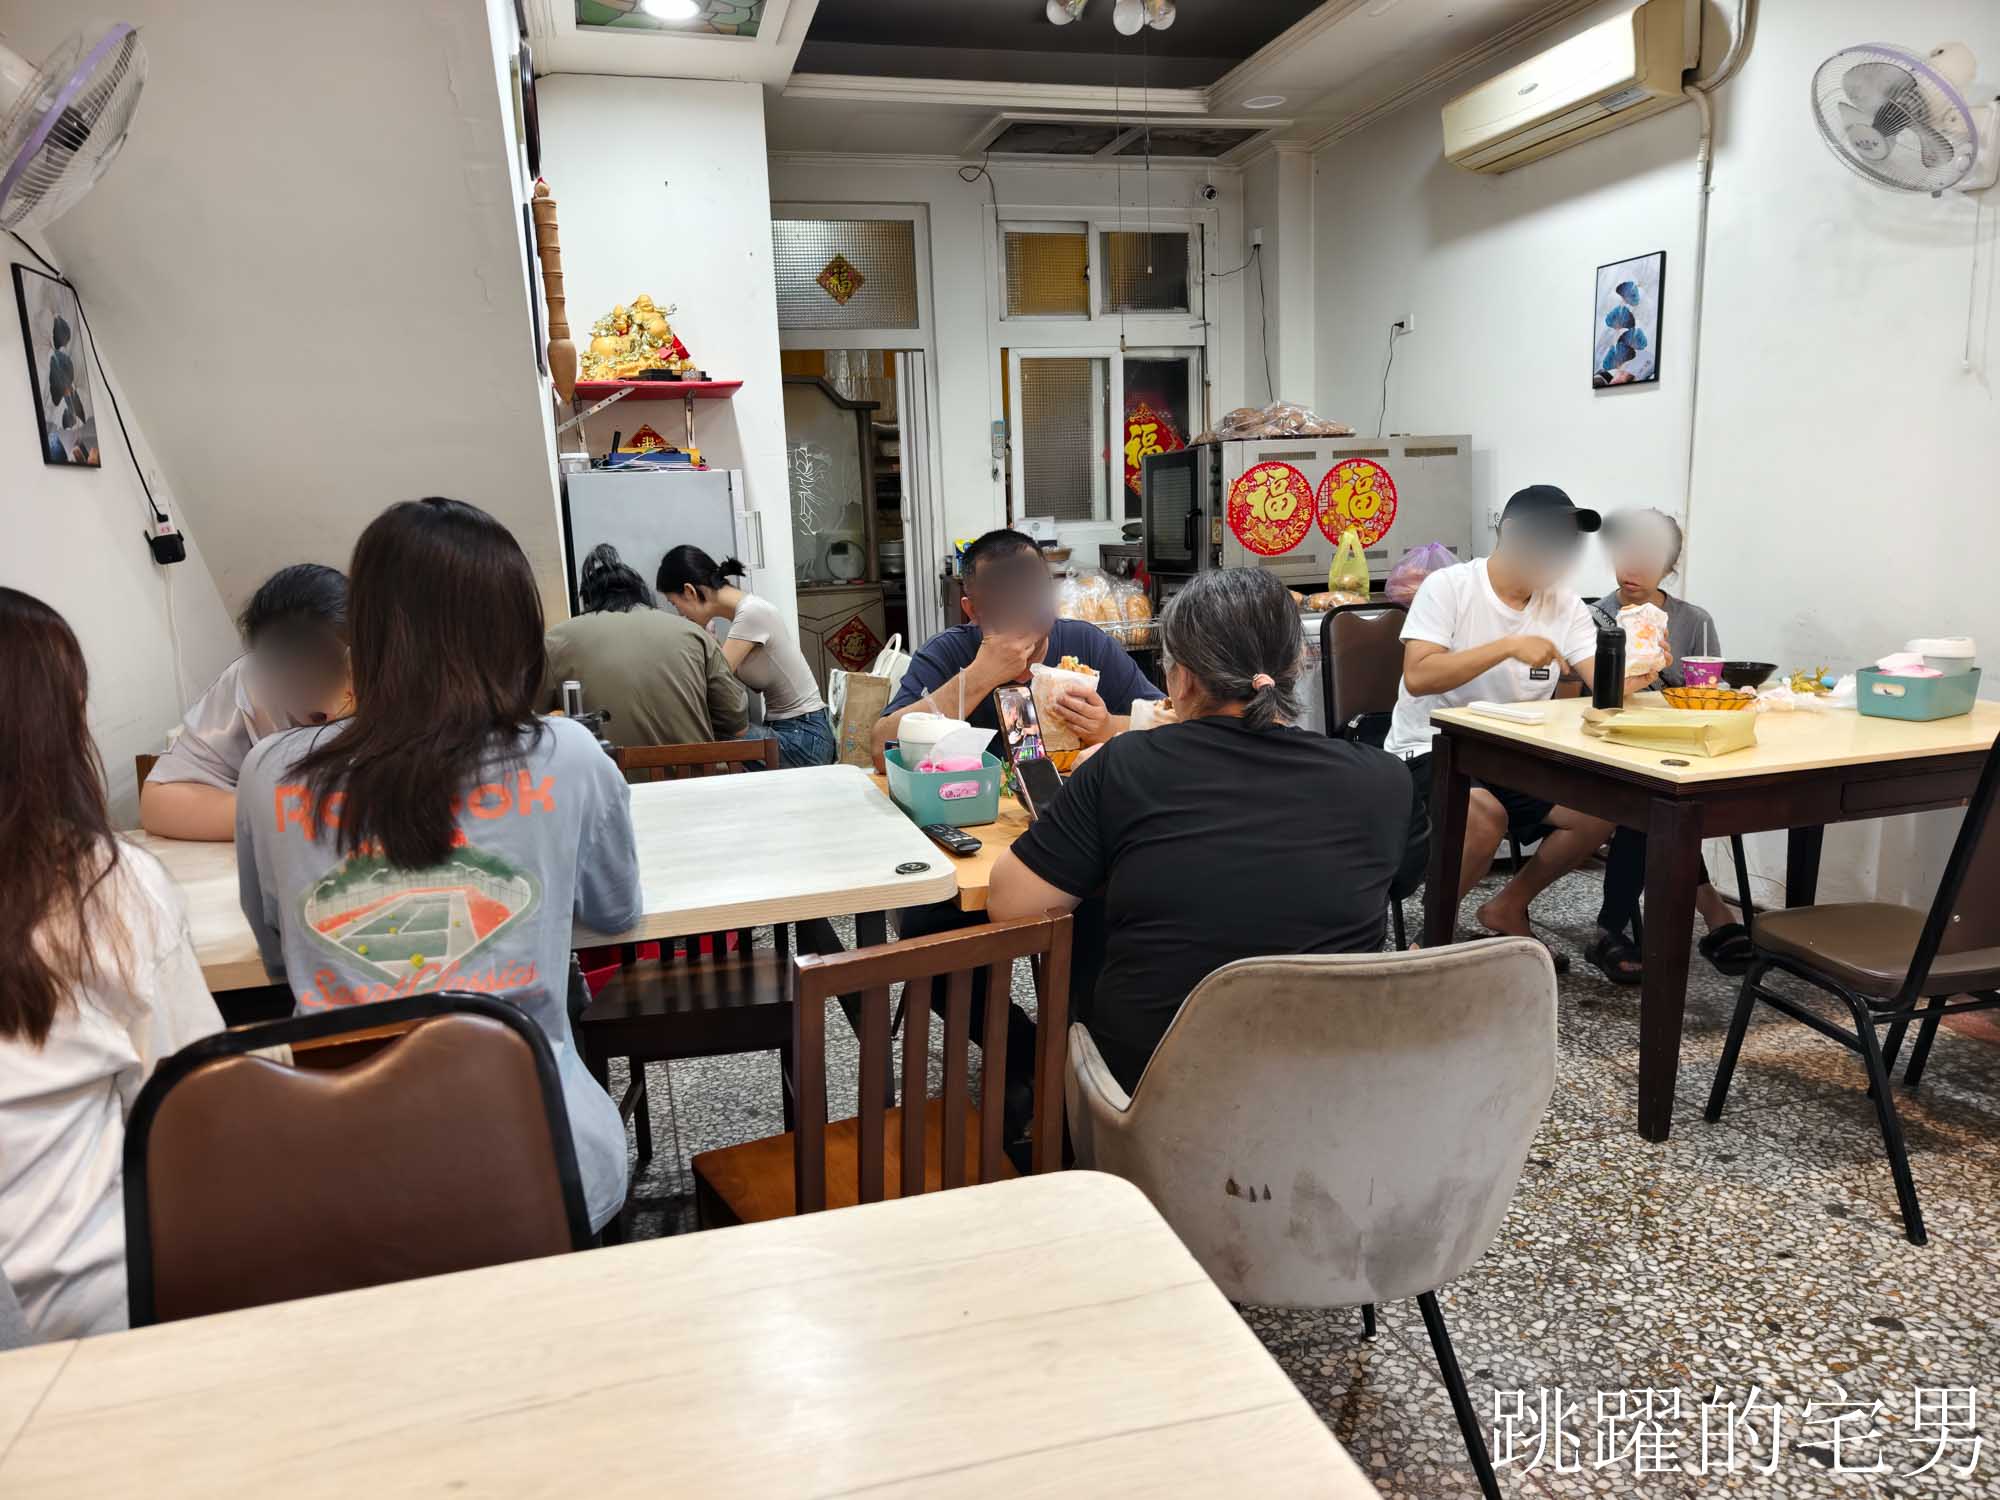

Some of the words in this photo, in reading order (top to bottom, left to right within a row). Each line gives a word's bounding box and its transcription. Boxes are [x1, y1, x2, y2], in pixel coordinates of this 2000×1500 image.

[1124, 422, 1164, 469] 福
[1245, 466, 1297, 522] 福
[1331, 464, 1382, 520] 福
